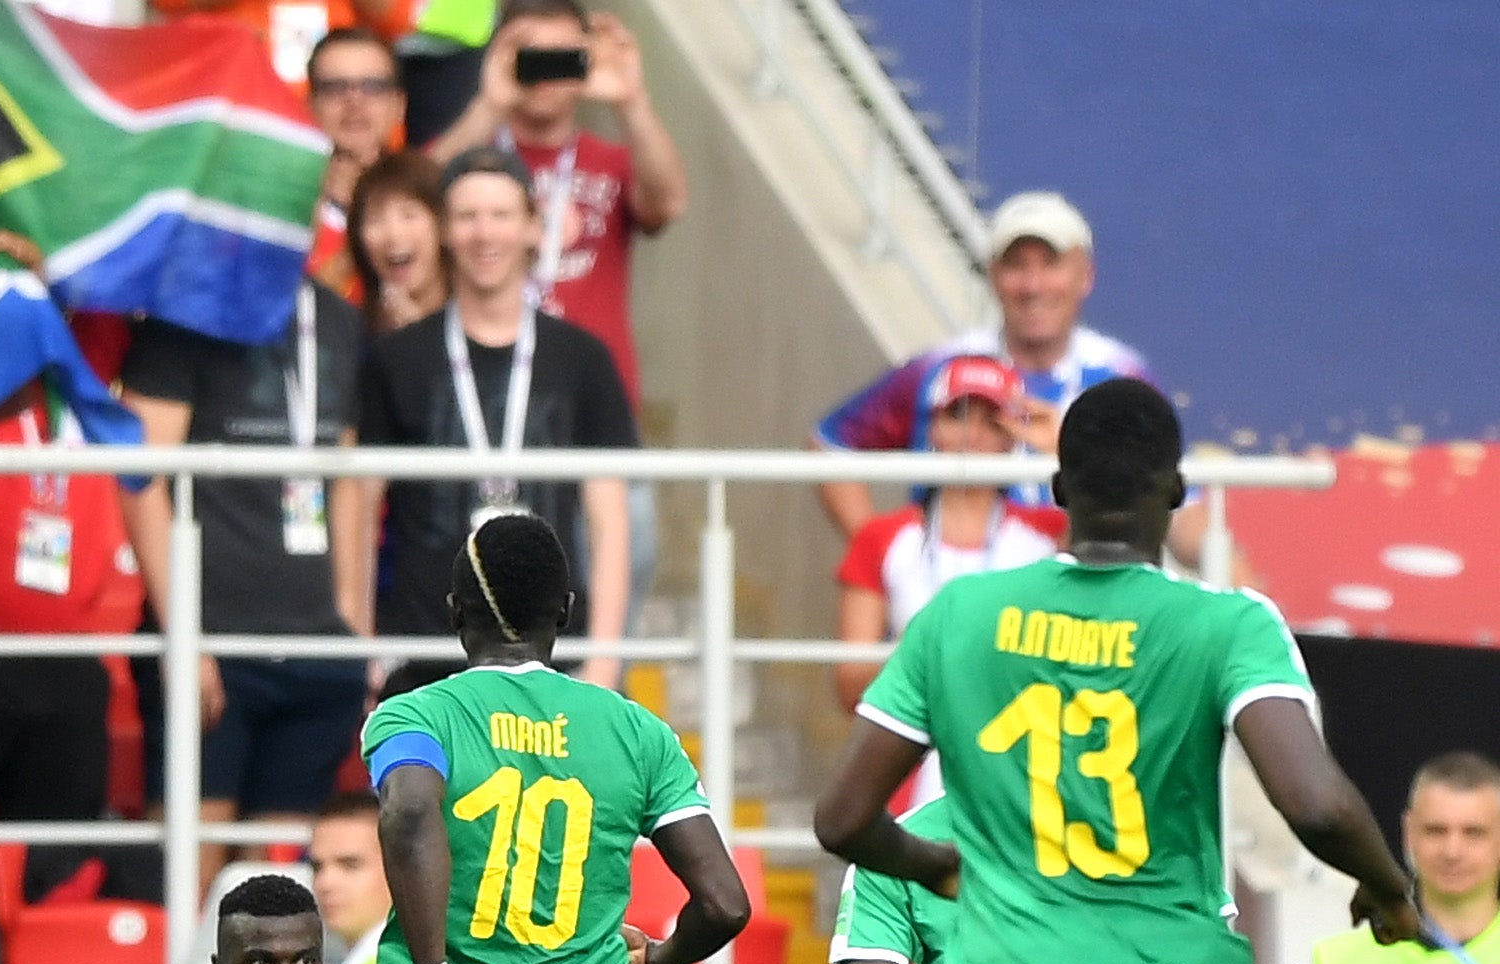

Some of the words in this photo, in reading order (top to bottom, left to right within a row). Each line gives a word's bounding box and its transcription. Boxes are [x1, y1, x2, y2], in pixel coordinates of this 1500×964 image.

[490, 712, 569, 757] MANÉ
[977, 683, 1150, 880] 13
[453, 767, 593, 950] 10
